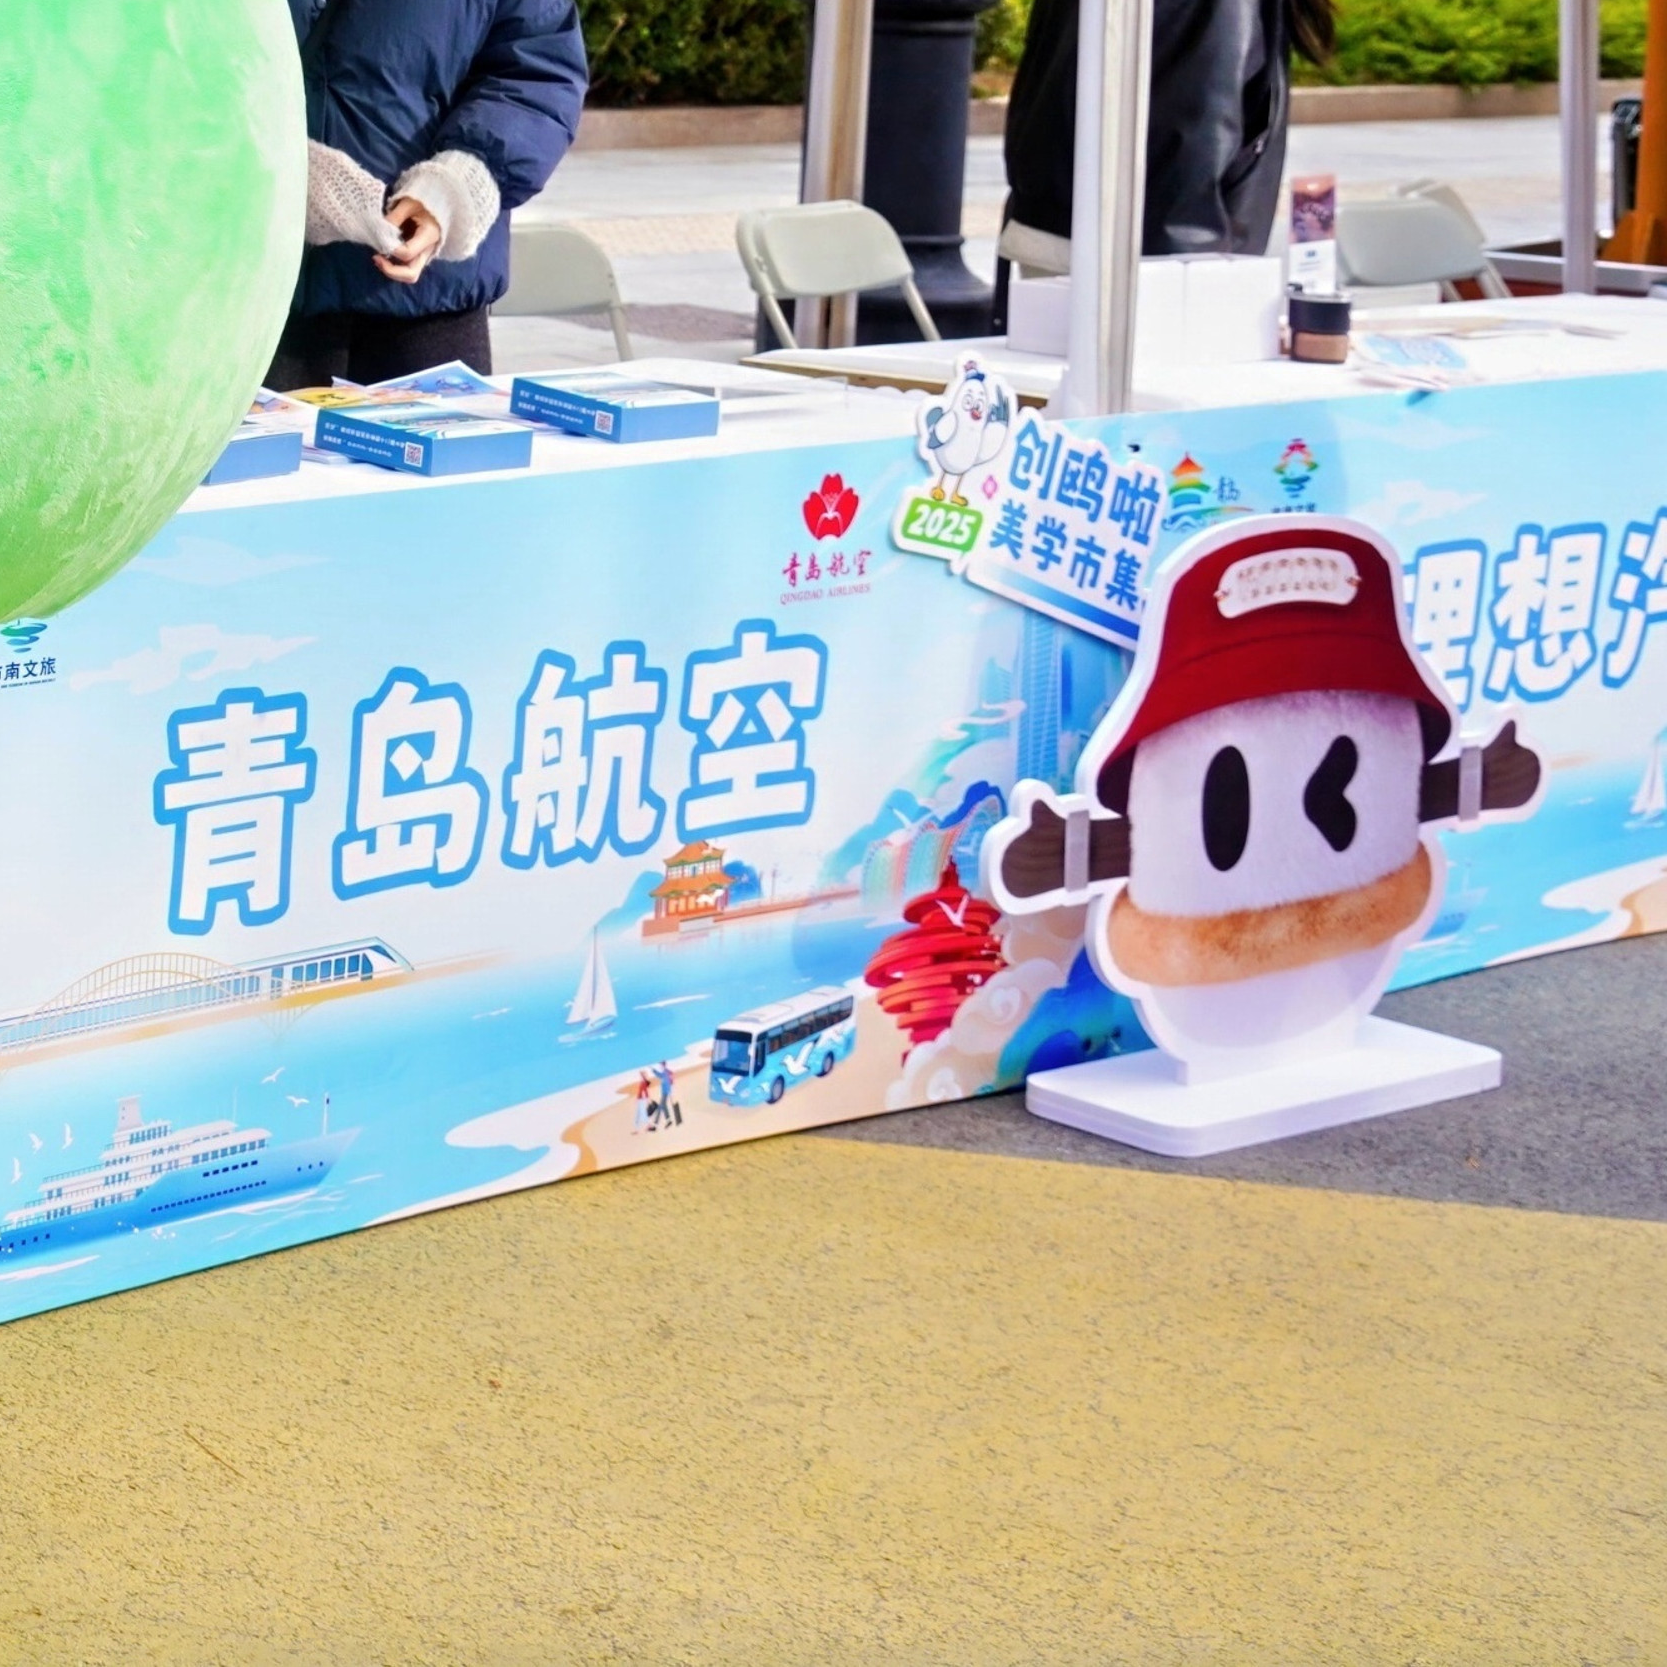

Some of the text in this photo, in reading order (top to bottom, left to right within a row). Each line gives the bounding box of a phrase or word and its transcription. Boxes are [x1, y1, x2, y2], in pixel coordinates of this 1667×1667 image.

[905, 503, 975, 546] 2025
[1009, 419, 1161, 548] 创鸥啦
[990, 498, 1141, 611] 美学市集
[153, 618, 829, 935] 青岛航空
